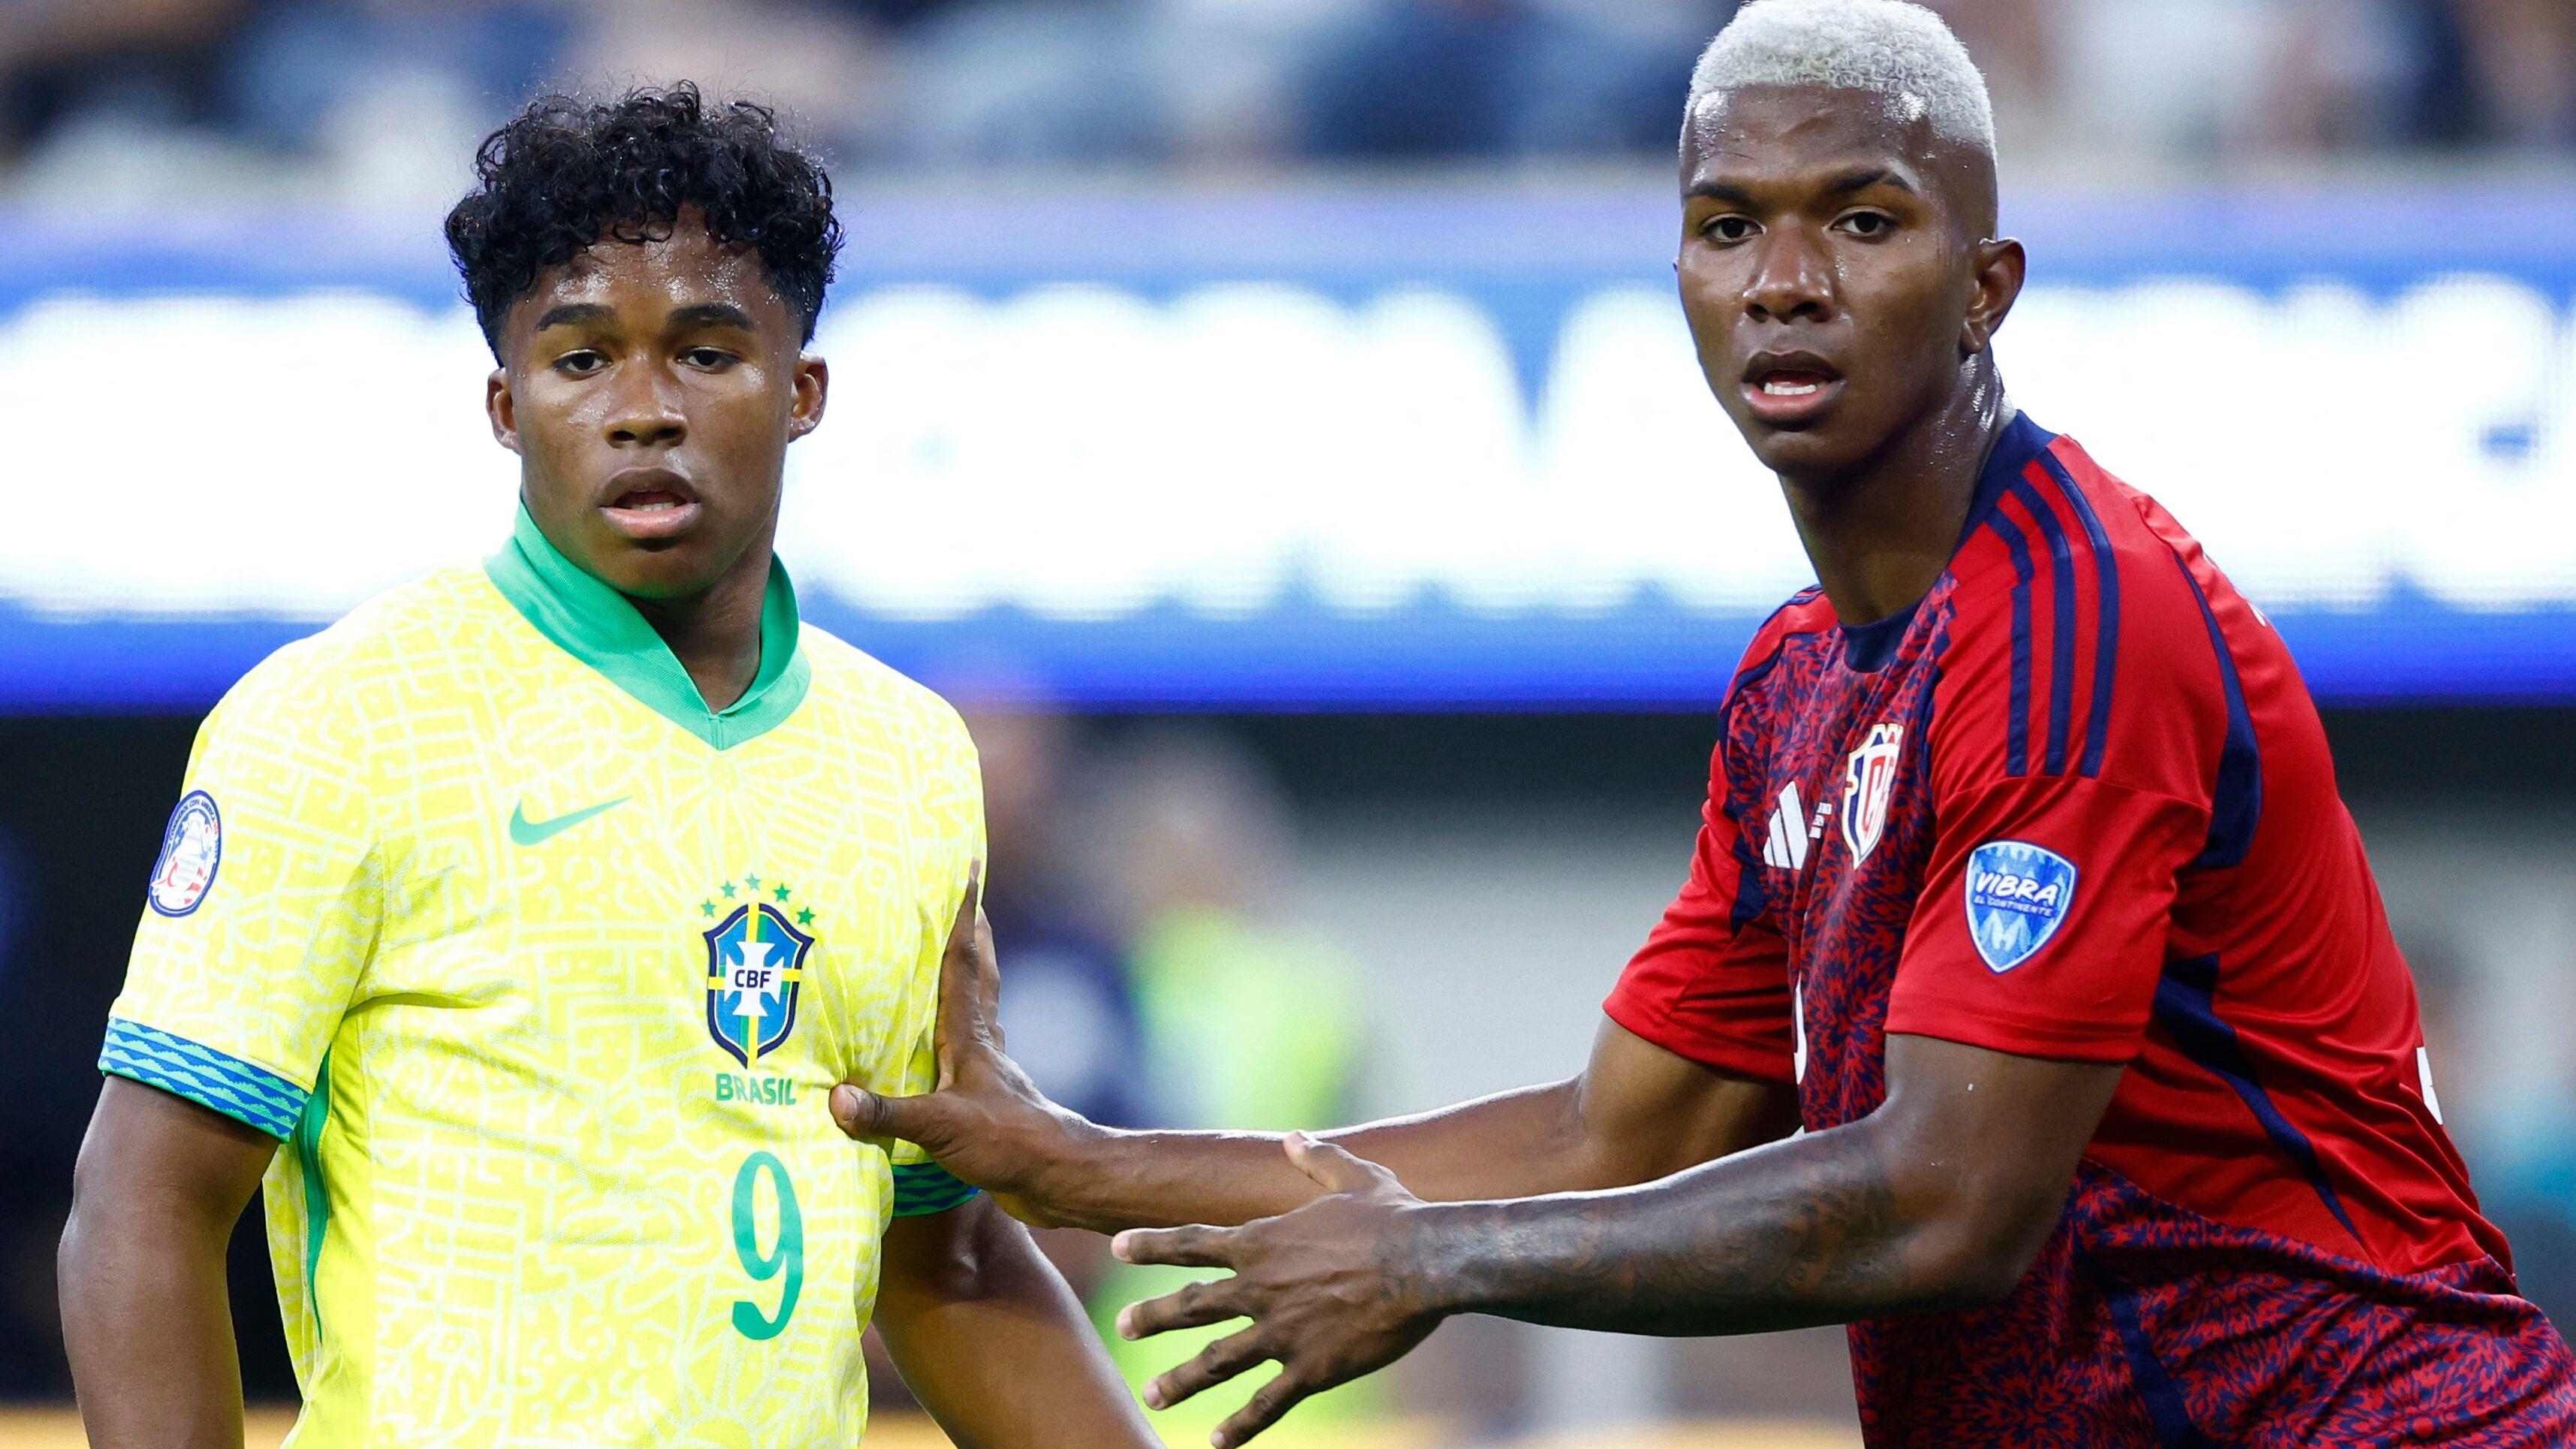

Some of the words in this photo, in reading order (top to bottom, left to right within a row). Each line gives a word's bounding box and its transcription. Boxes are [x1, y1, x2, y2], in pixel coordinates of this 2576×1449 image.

[1976, 871, 2059, 906] VIBRA
[734, 969, 772, 989] CBF
[716, 1073, 797, 1106] BRASIL
[731, 1150, 804, 1340] 9
